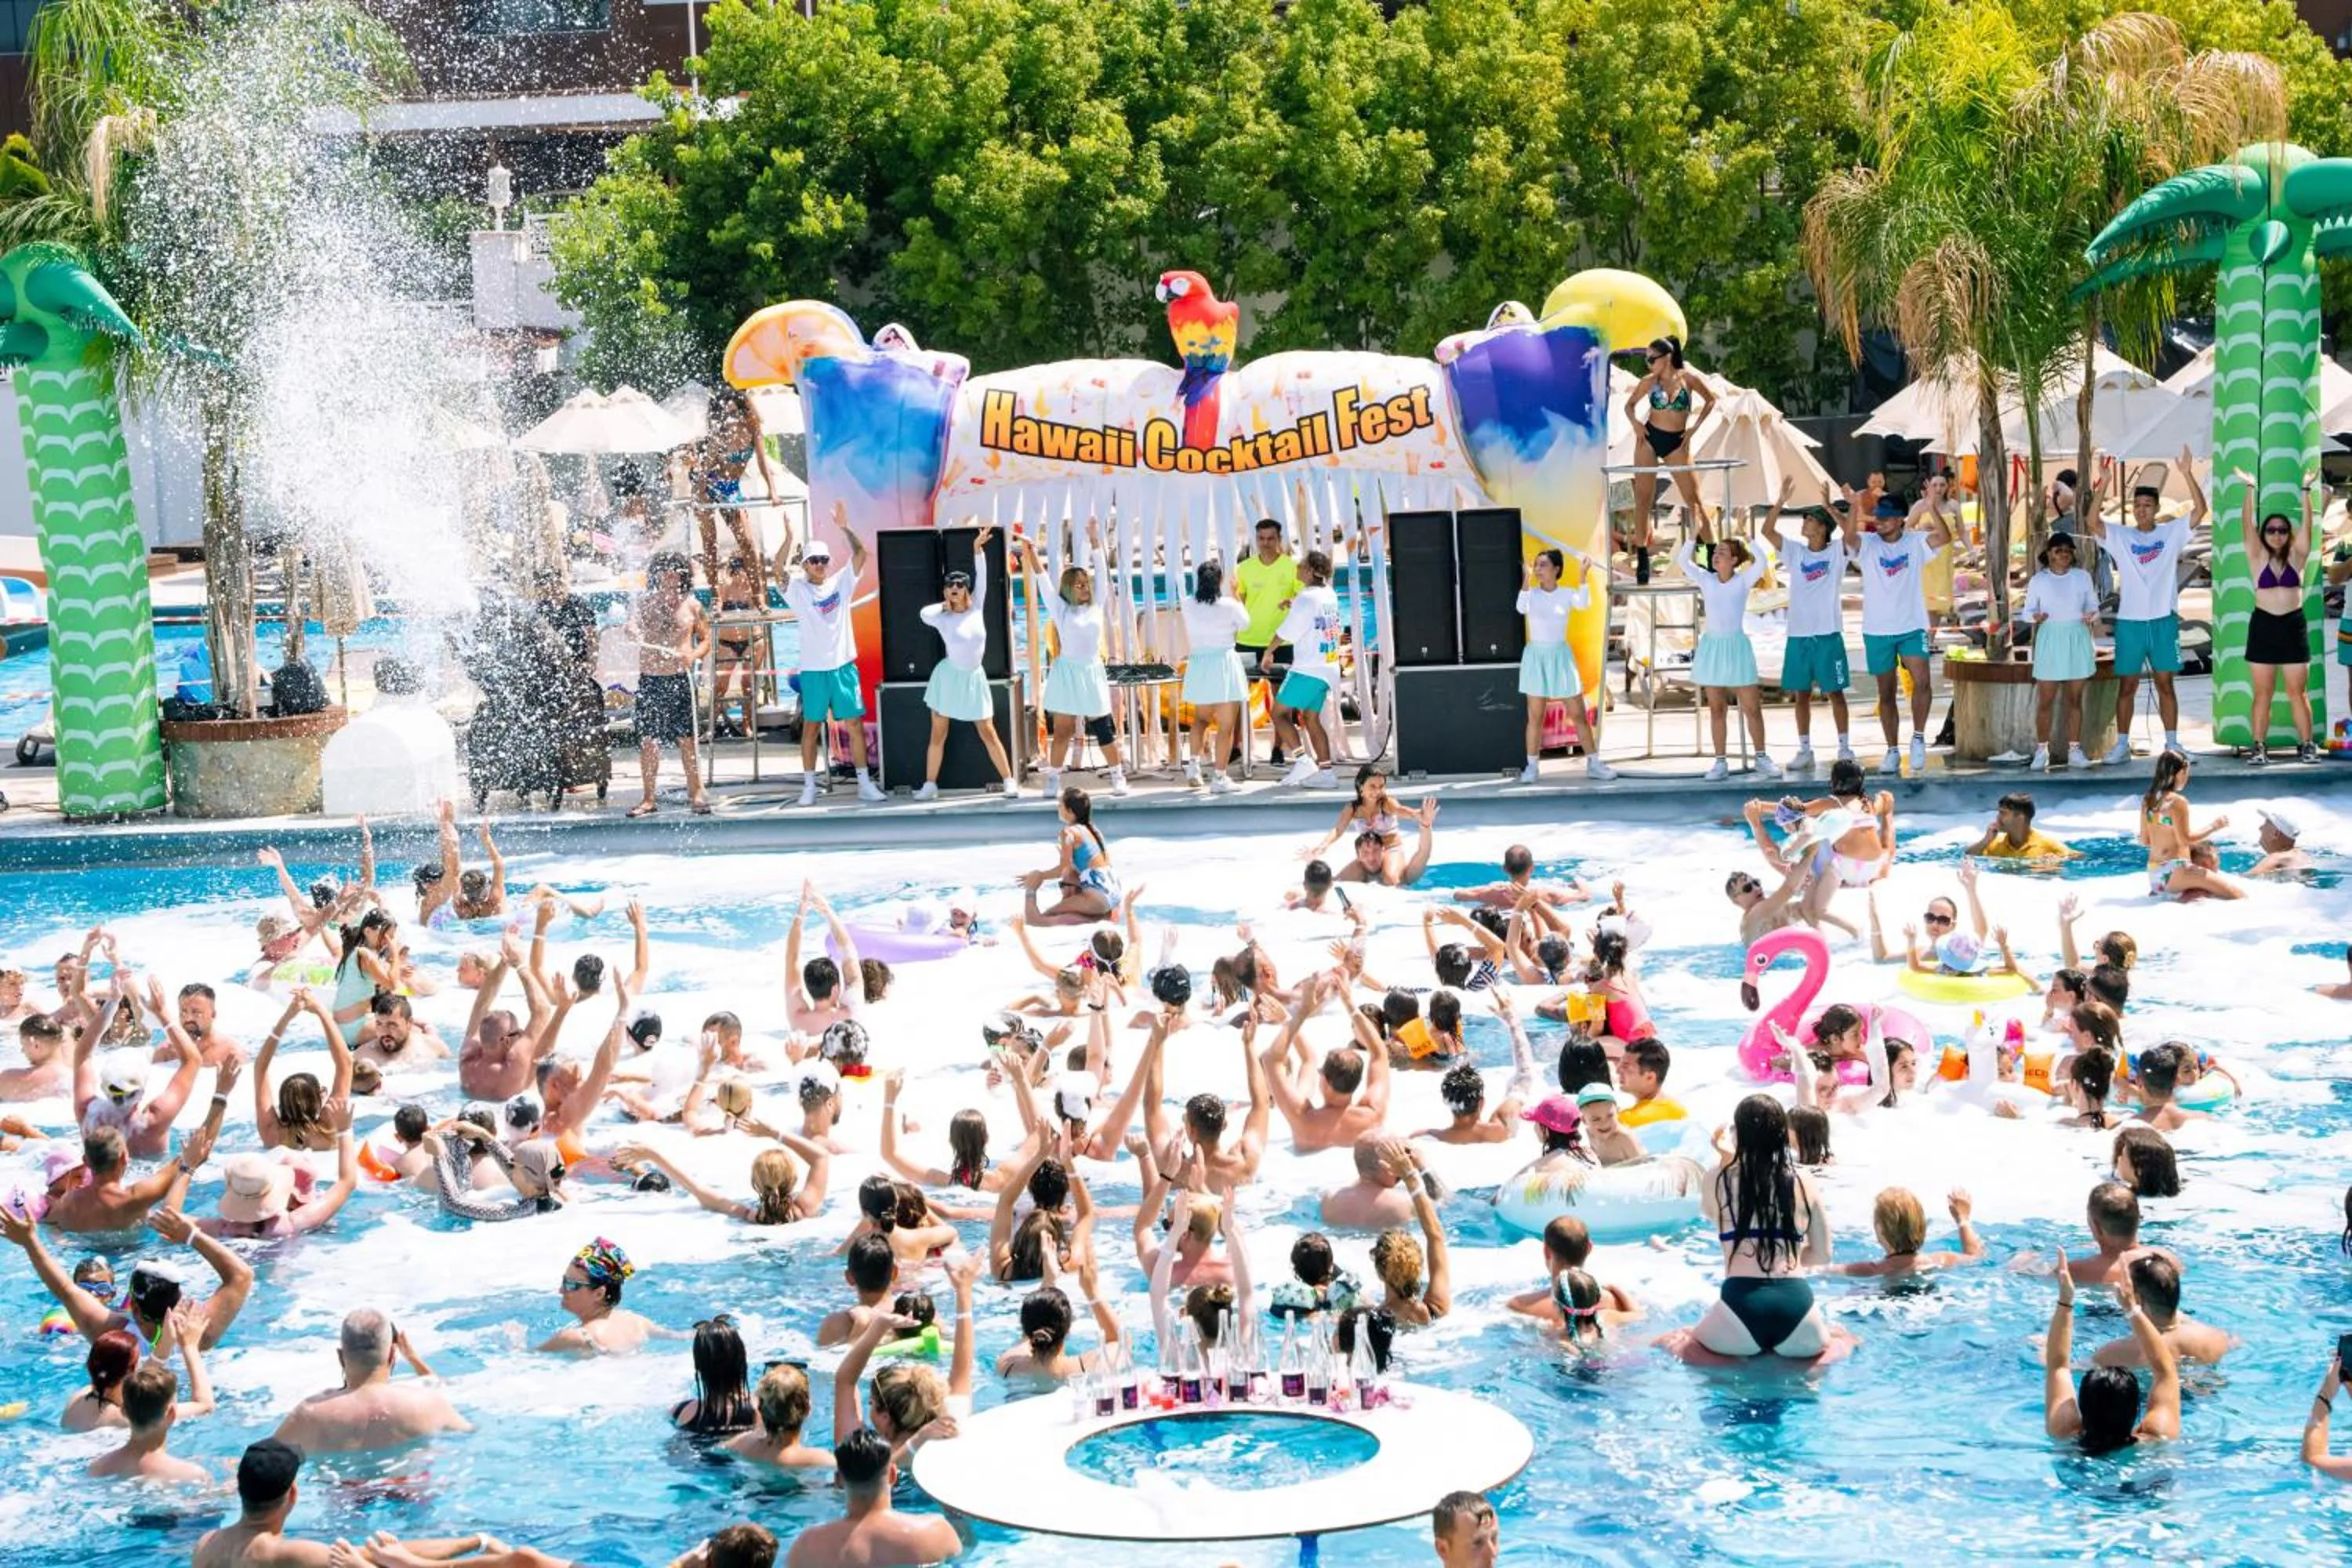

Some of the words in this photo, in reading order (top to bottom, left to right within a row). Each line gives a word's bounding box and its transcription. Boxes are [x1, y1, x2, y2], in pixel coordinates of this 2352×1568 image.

[981, 390, 1136, 467] Hawaii
[1143, 412, 1332, 473] Cocktail
[1333, 384, 1433, 450] Fest
